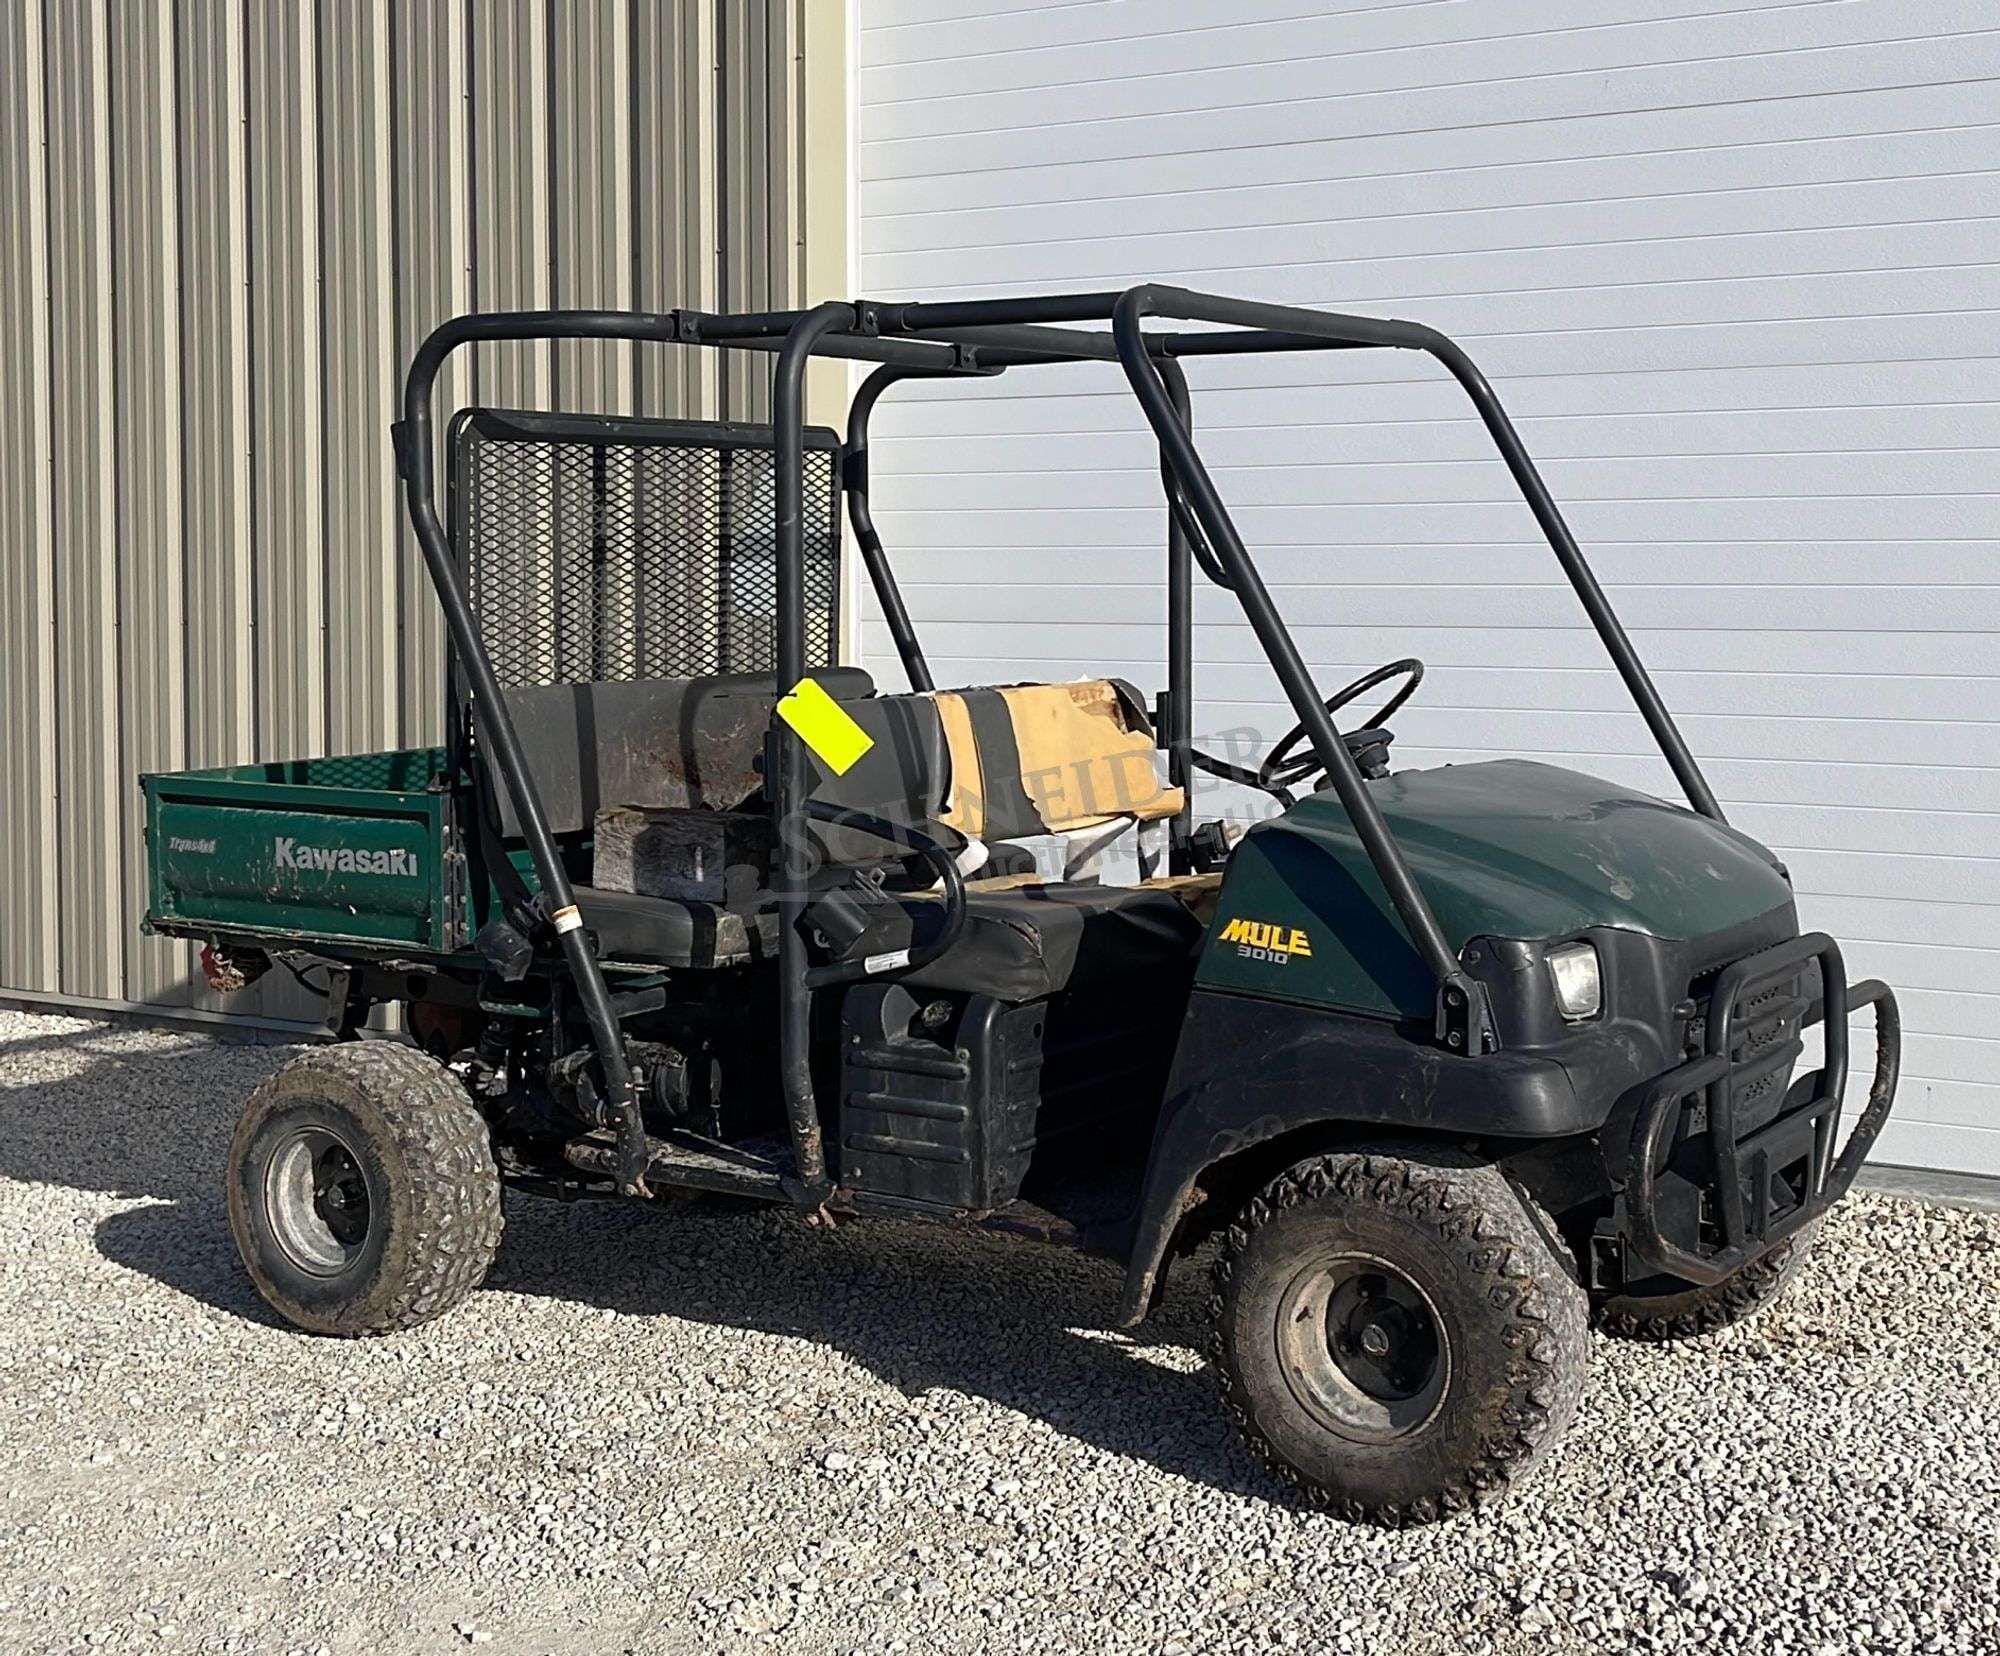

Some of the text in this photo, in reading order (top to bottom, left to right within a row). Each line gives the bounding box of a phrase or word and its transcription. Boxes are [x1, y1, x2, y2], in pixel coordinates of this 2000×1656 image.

[274, 836, 418, 877] Kawasaki
[1217, 918, 1313, 957] MULE
[1237, 944, 1289, 965] 3010
